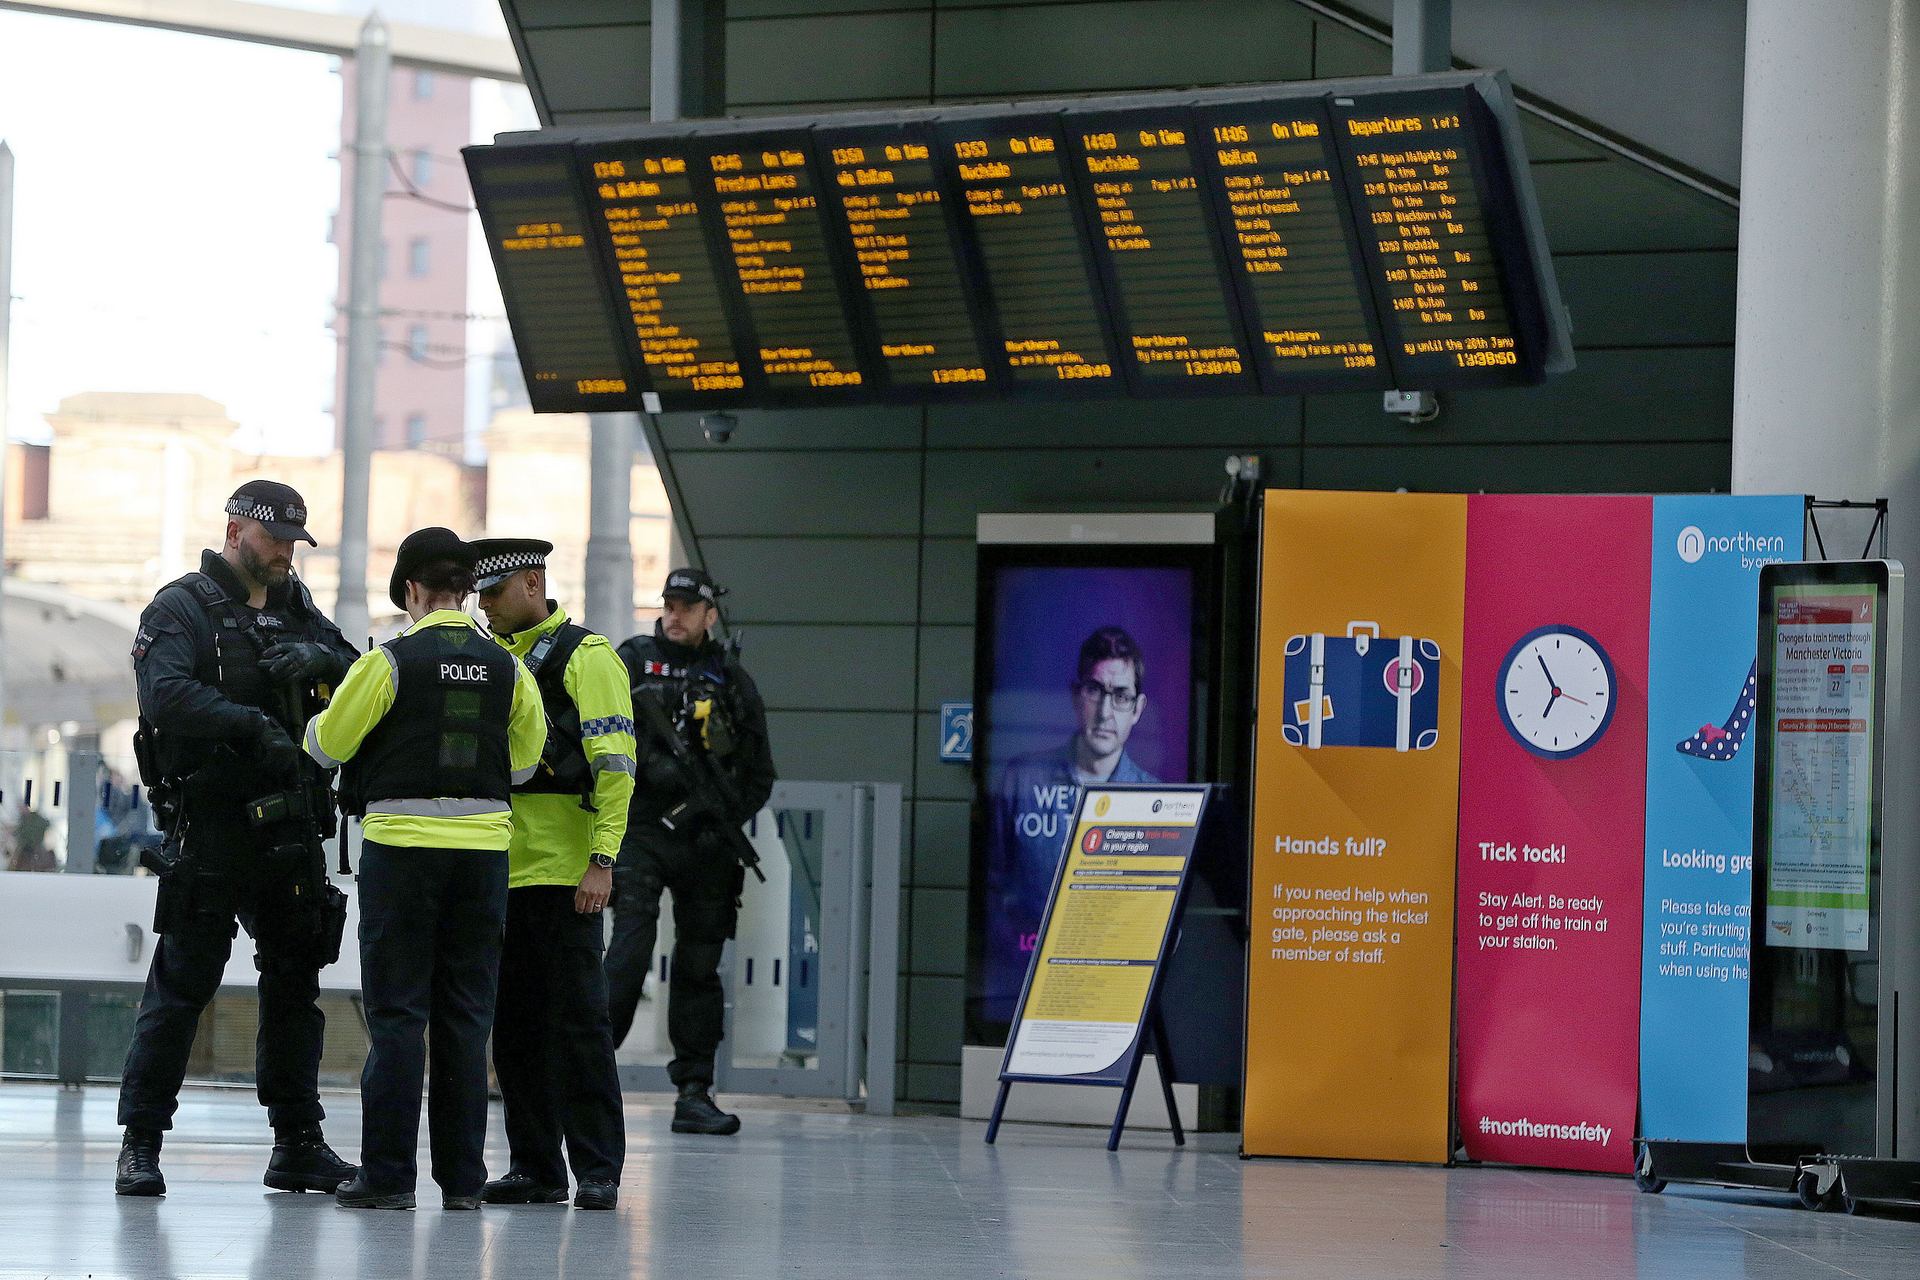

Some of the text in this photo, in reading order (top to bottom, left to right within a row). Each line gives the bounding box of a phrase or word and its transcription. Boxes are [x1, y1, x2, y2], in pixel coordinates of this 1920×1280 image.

[1272, 123, 1290, 139] On
[1291, 122, 1319, 137] time
[1347, 118, 1423, 136] Departures
[1440, 118, 1450, 128] of
[1218, 149, 1258, 166] Bolton
[1708, 531, 1784, 552] northern
[1741, 554, 1755, 571] by
[1779, 631, 1871, 646] Changes to train times through
[1786, 647, 1862, 660] Manchester Victoria
[441, 664, 488, 681] POLICE
[1106, 828, 1135, 841] Changes
[1136, 830, 1144, 839] to
[1110, 844, 1126, 854] your
[1127, 842, 1149, 854] region
[1275, 835, 1387, 857] Hands full?
[1479, 842, 1566, 864] Tick tock!
[1663, 848, 1726, 874] Looking
[1273, 884, 1428, 906] If you need help when
[1479, 891, 1603, 914] Stay Alert. Be ready
[1272, 906, 1429, 925] approaching the ticket
[1661, 898, 1702, 915] Please
[1705, 900, 1731, 916] take
[1479, 913, 1608, 932] to get off the train at
[1660, 921, 1745, 941] you're strutting
[1272, 926, 1400, 944] gate, please ask a
[1479, 934, 1558, 950] your station.
[1272, 946, 1386, 964] member of staff.
[1660, 940, 1689, 956] stuff.
[1659, 961, 1748, 982] when using the
[1479, 1115, 1612, 1146] #northernsafety
